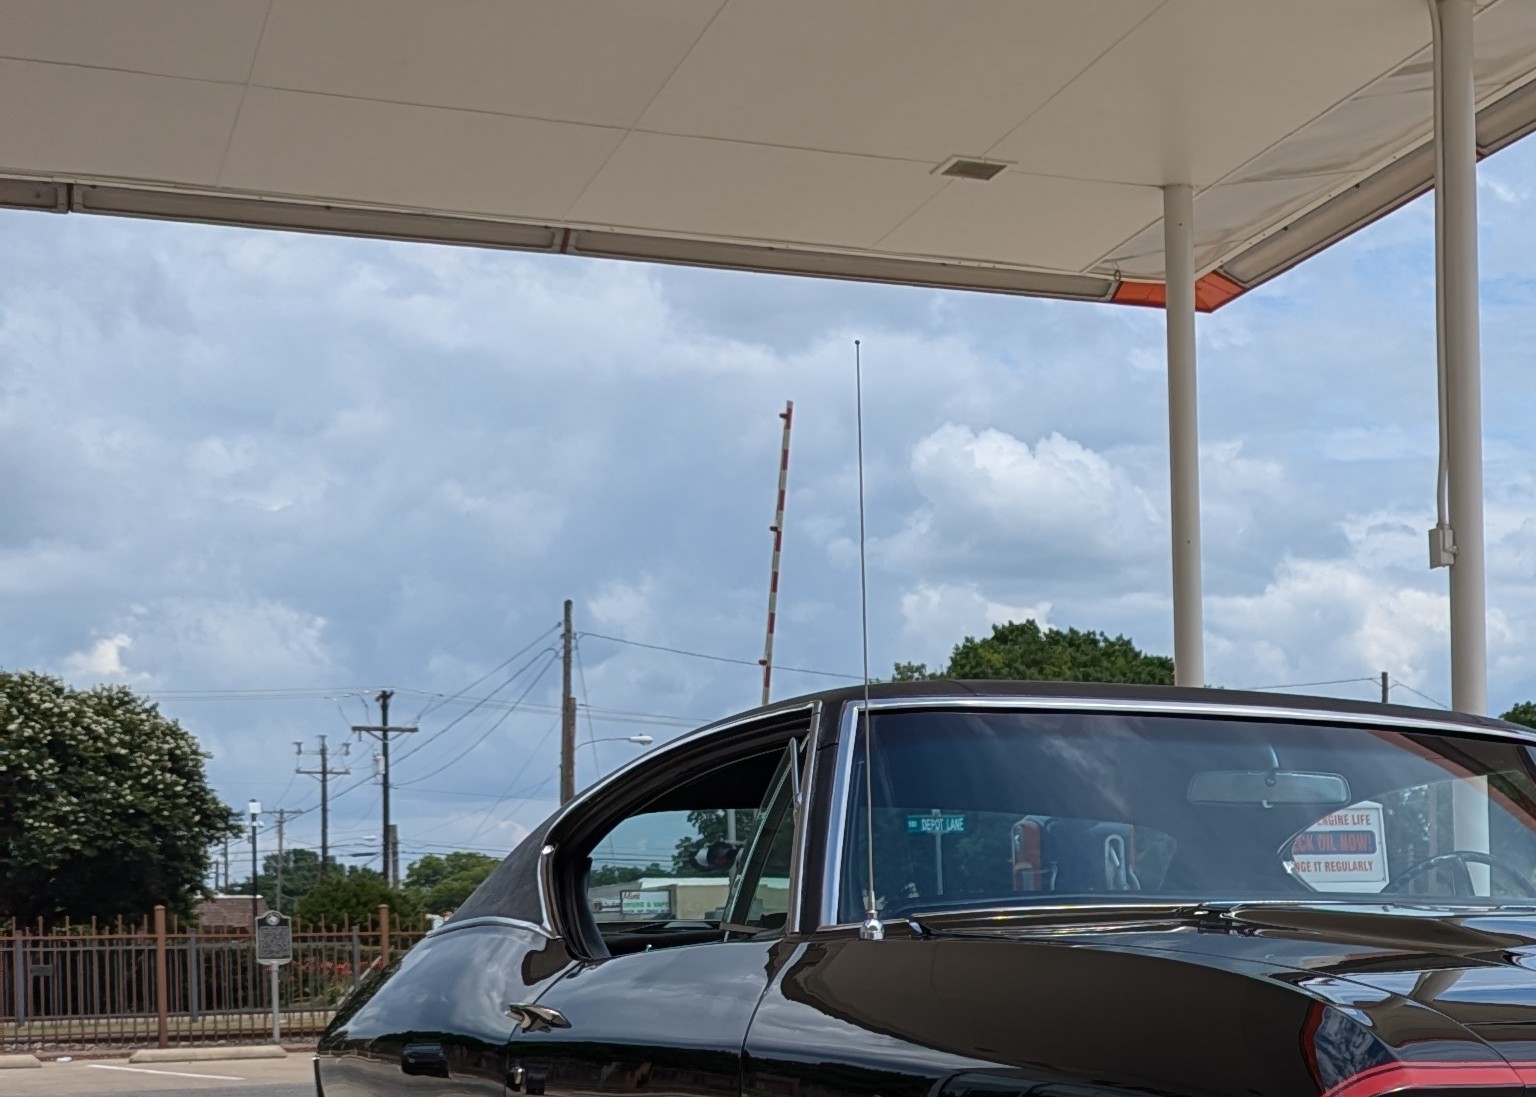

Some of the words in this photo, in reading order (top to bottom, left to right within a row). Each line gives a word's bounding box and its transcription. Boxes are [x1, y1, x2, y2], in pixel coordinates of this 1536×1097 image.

[922, 818, 943, 831] DEPOT
[947, 818, 964, 831] LANE
[1352, 814, 1372, 826] LIFE
[1318, 833, 1336, 851] OIL
[1314, 861, 1322, 872] IT
[1325, 861, 1374, 873] REGULARLY
